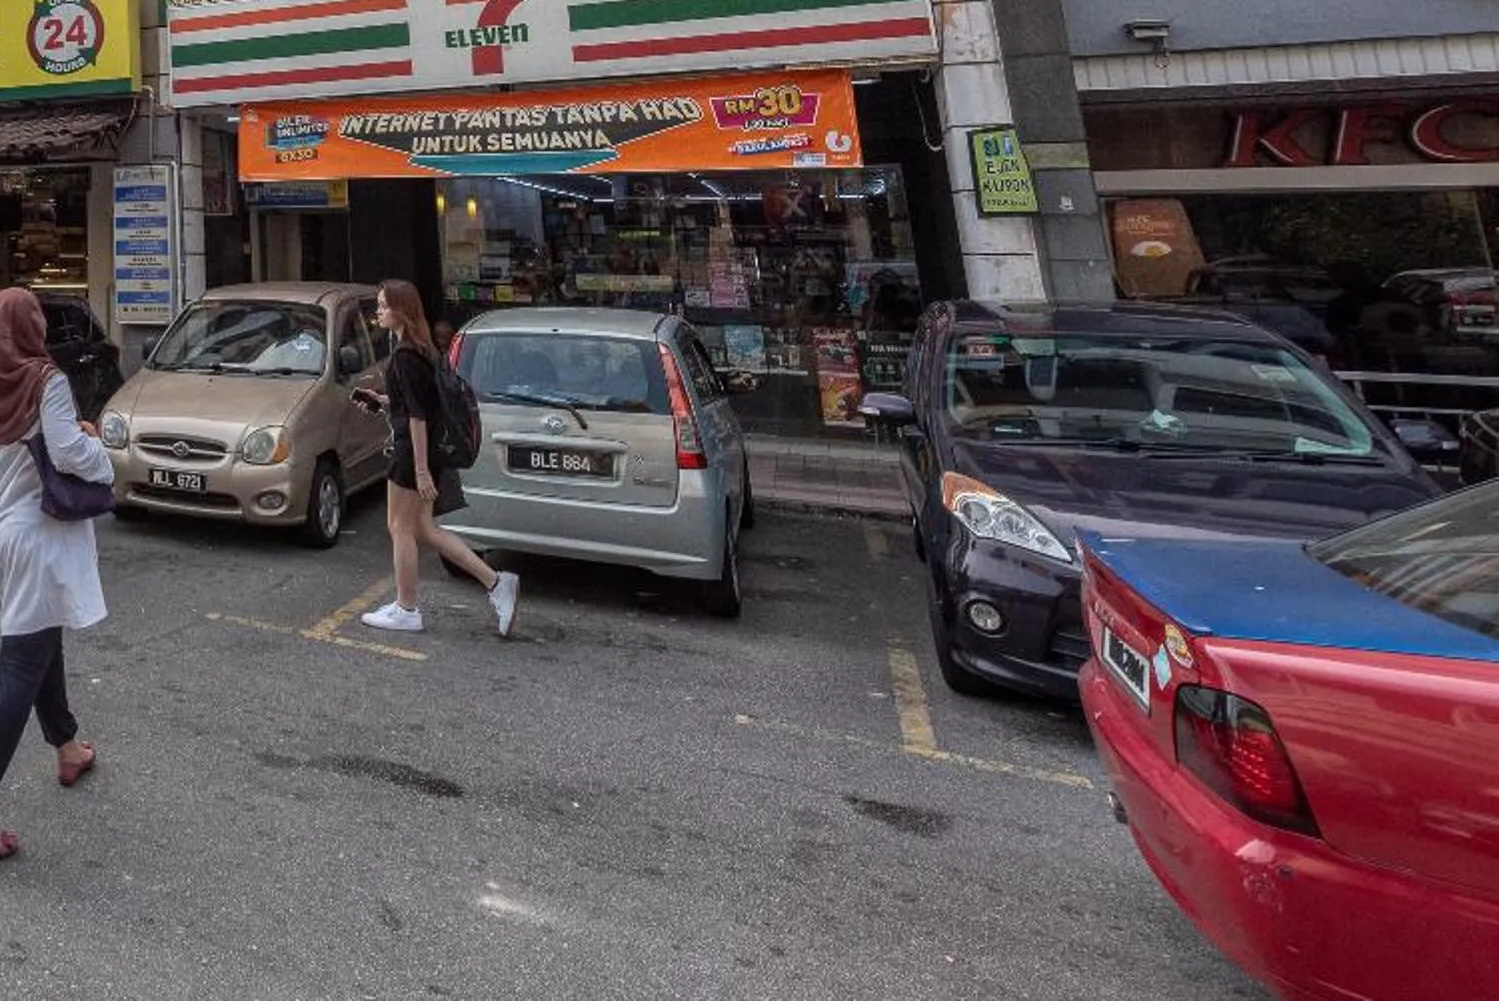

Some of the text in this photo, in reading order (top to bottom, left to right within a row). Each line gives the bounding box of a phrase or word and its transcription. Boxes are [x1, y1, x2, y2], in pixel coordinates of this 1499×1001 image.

[43, 15, 88, 51] 24
[339, 96, 700, 137] INTERNET PANTAS TANPA HAD
[725, 86, 802, 116] RM 30
[412, 129, 613, 155] UNTUK SEMUANYA
[1223, 102, 1499, 168] KFC
[531, 453, 557, 469] BLE
